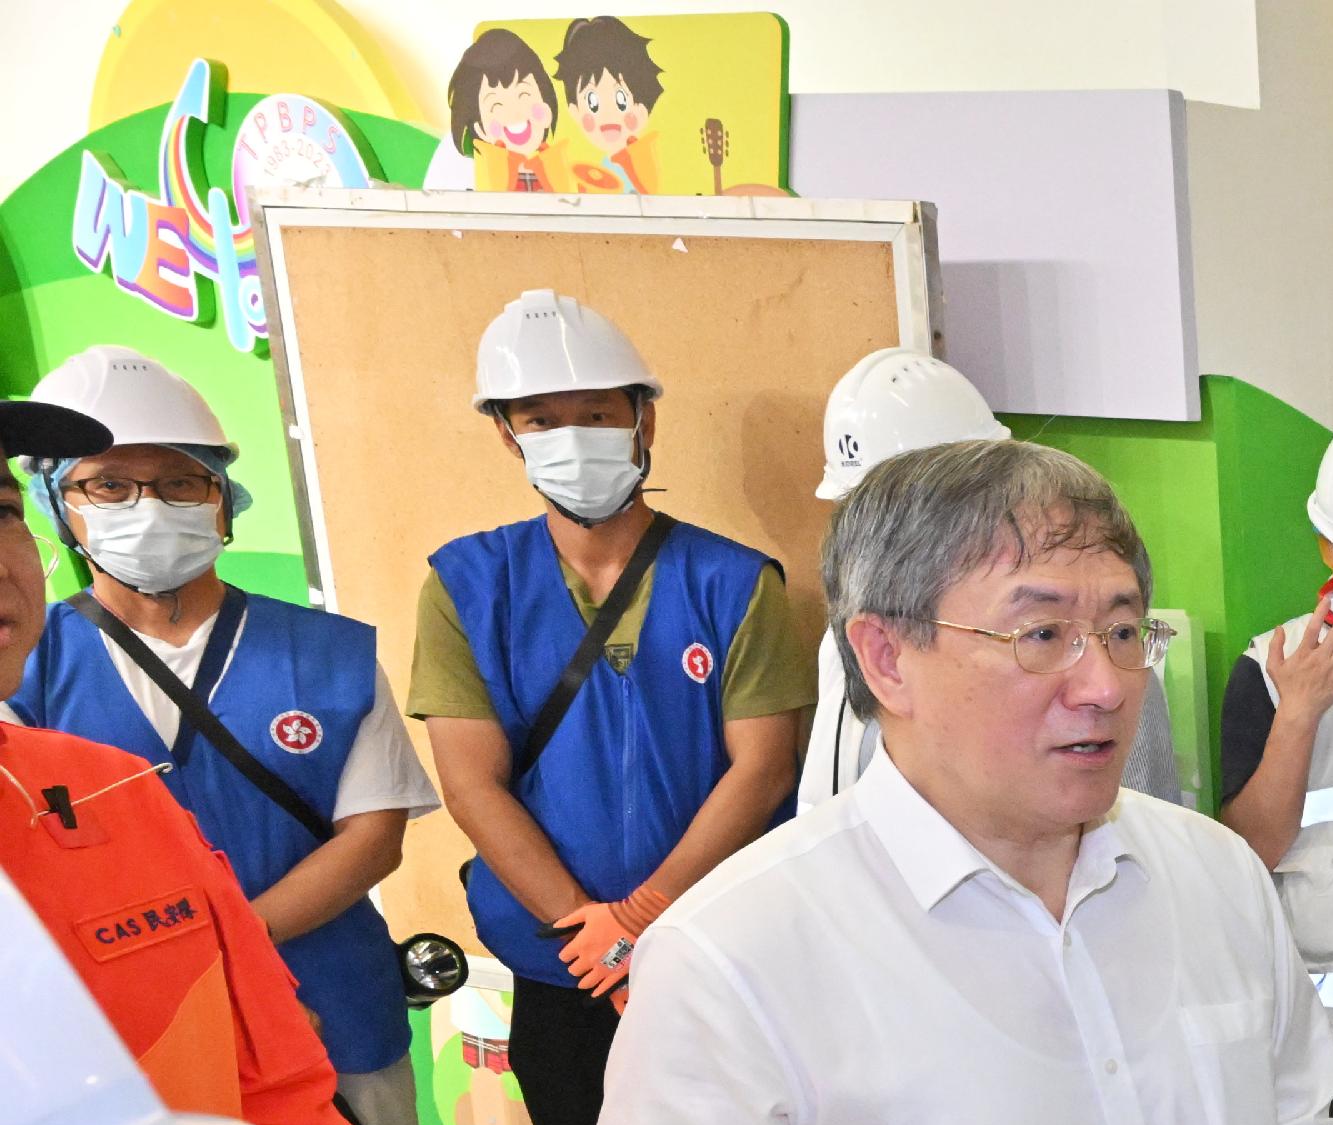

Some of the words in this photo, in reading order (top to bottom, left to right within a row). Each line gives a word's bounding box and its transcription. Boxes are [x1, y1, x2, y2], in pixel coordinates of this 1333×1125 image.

[238, 101, 341, 161] TPBPS
[73, 150, 198, 321] WE
[95, 918, 142, 945] CAS
